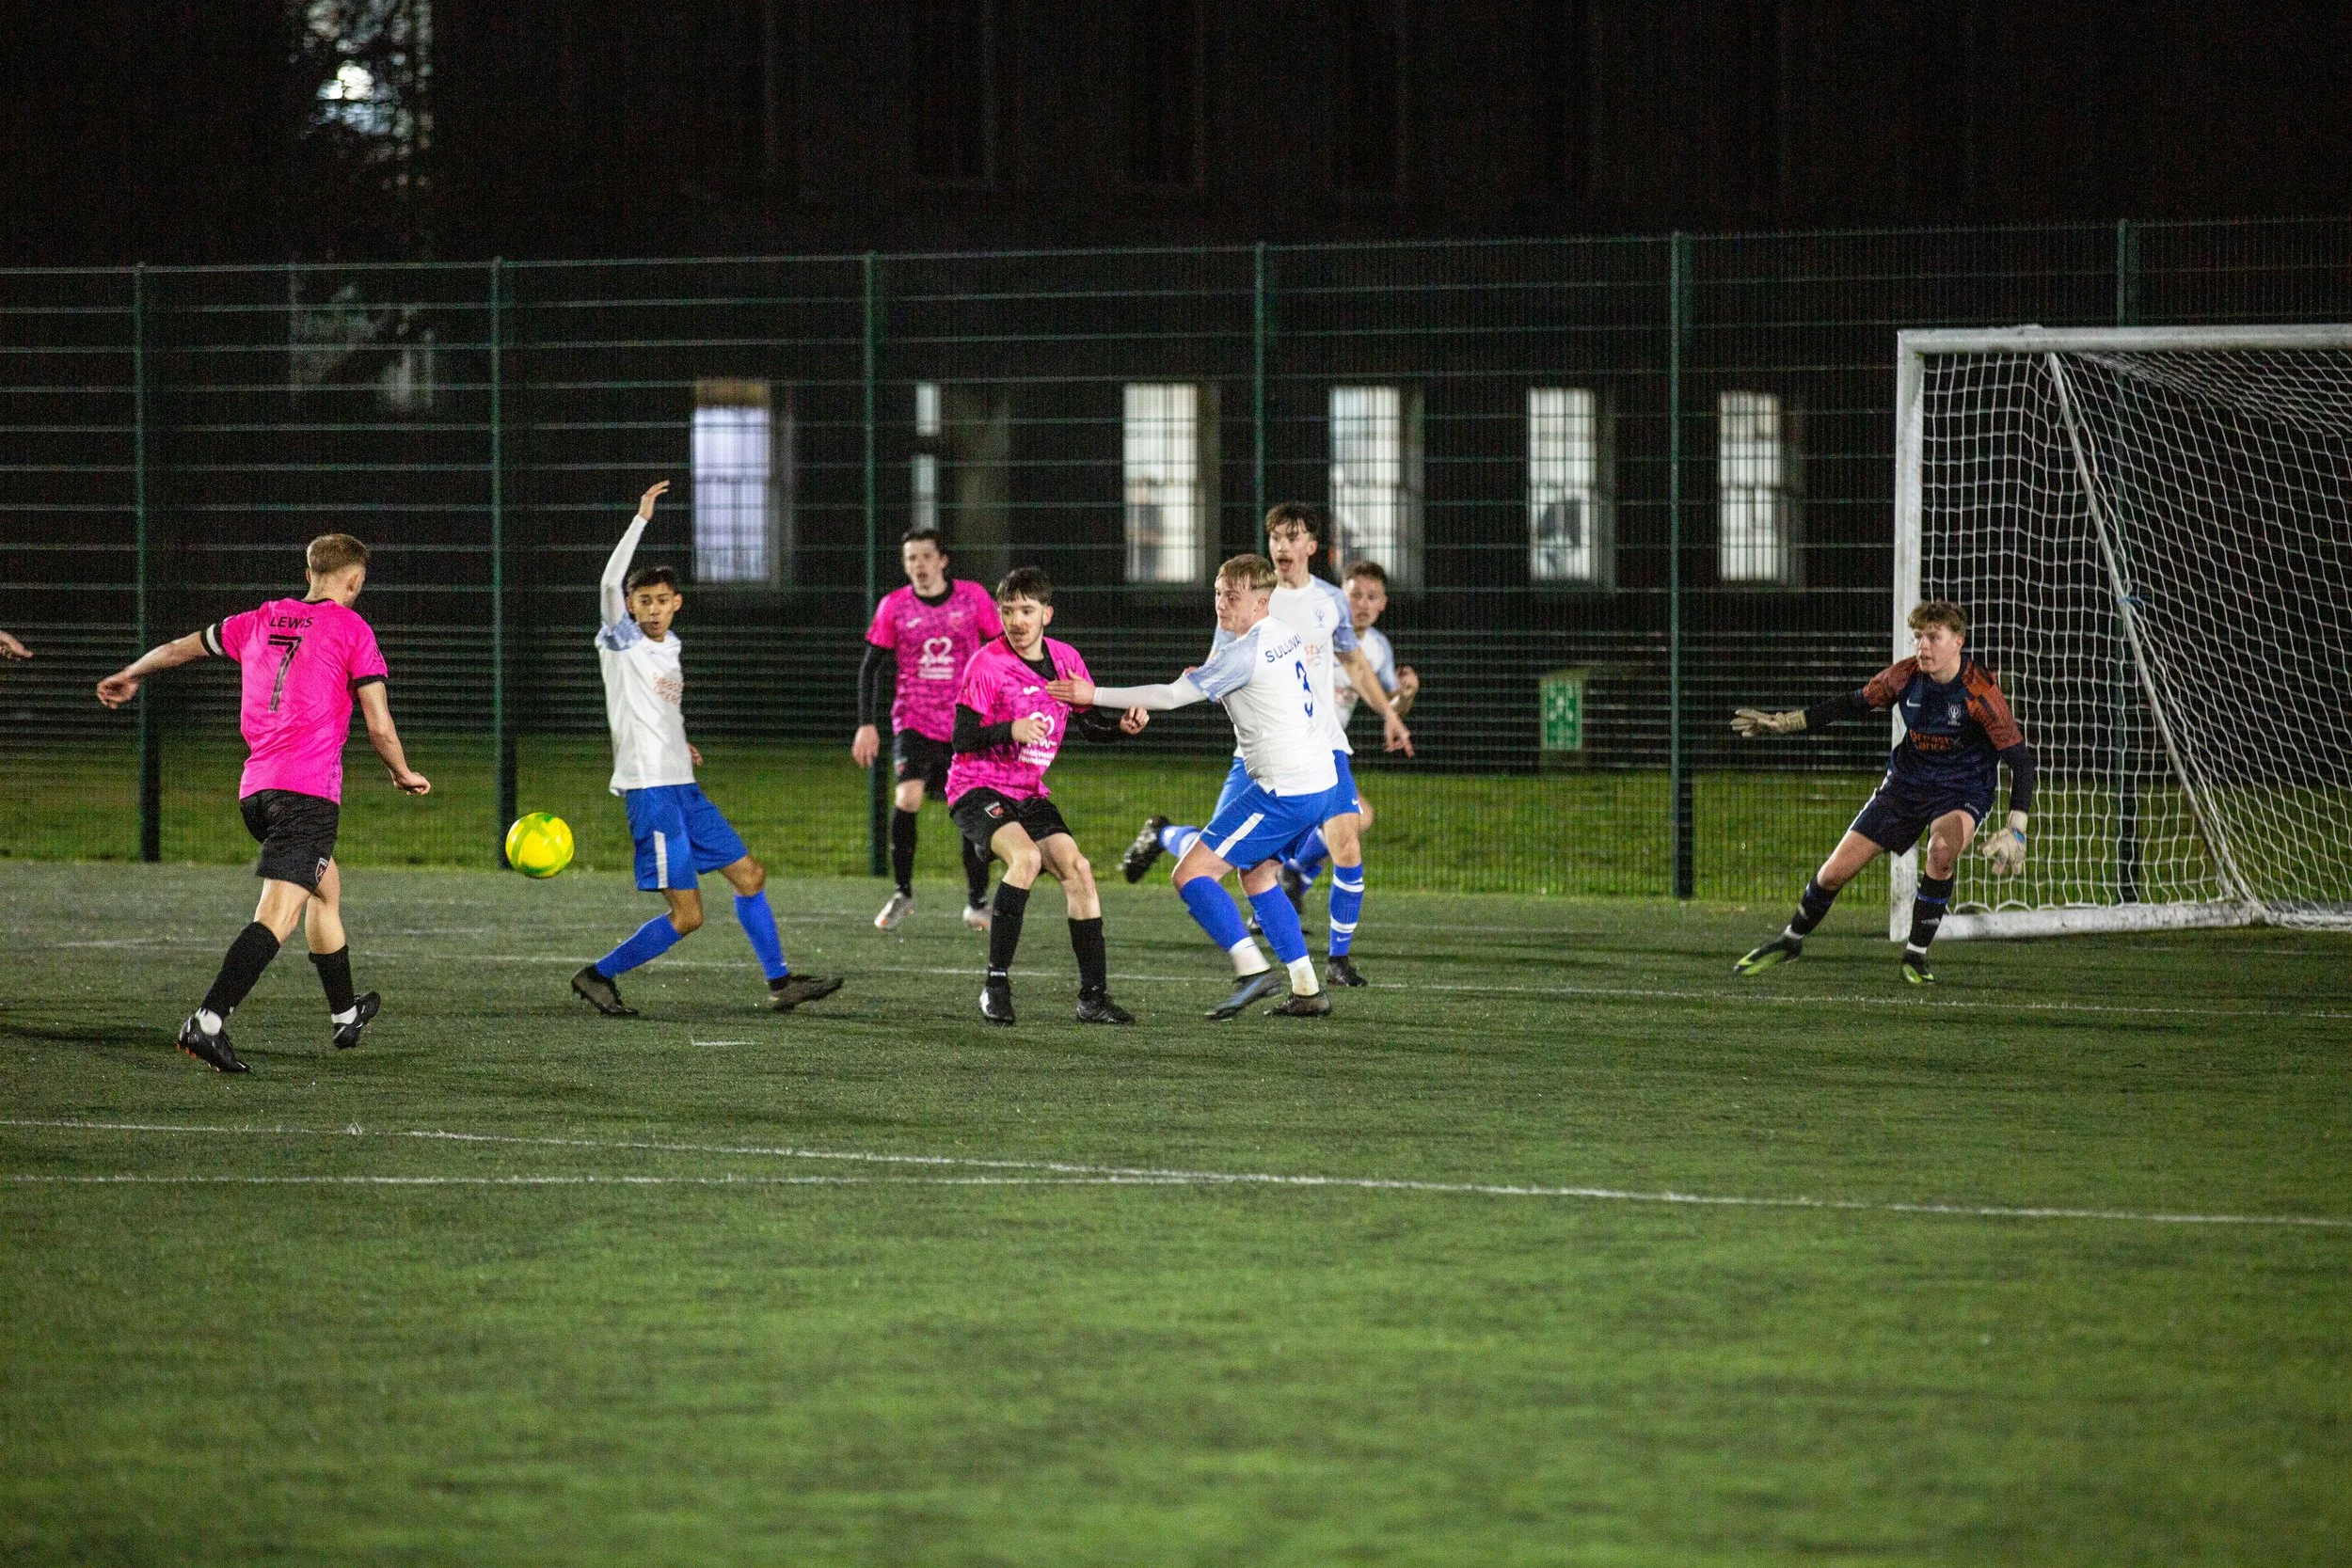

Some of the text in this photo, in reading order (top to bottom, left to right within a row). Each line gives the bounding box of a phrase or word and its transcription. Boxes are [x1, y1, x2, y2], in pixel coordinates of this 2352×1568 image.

[269, 616, 313, 628] LEWIS
[1265, 633, 1302, 663] SULLIVA
[268, 634, 303, 712] 7
[1295, 660, 1314, 718] 3
